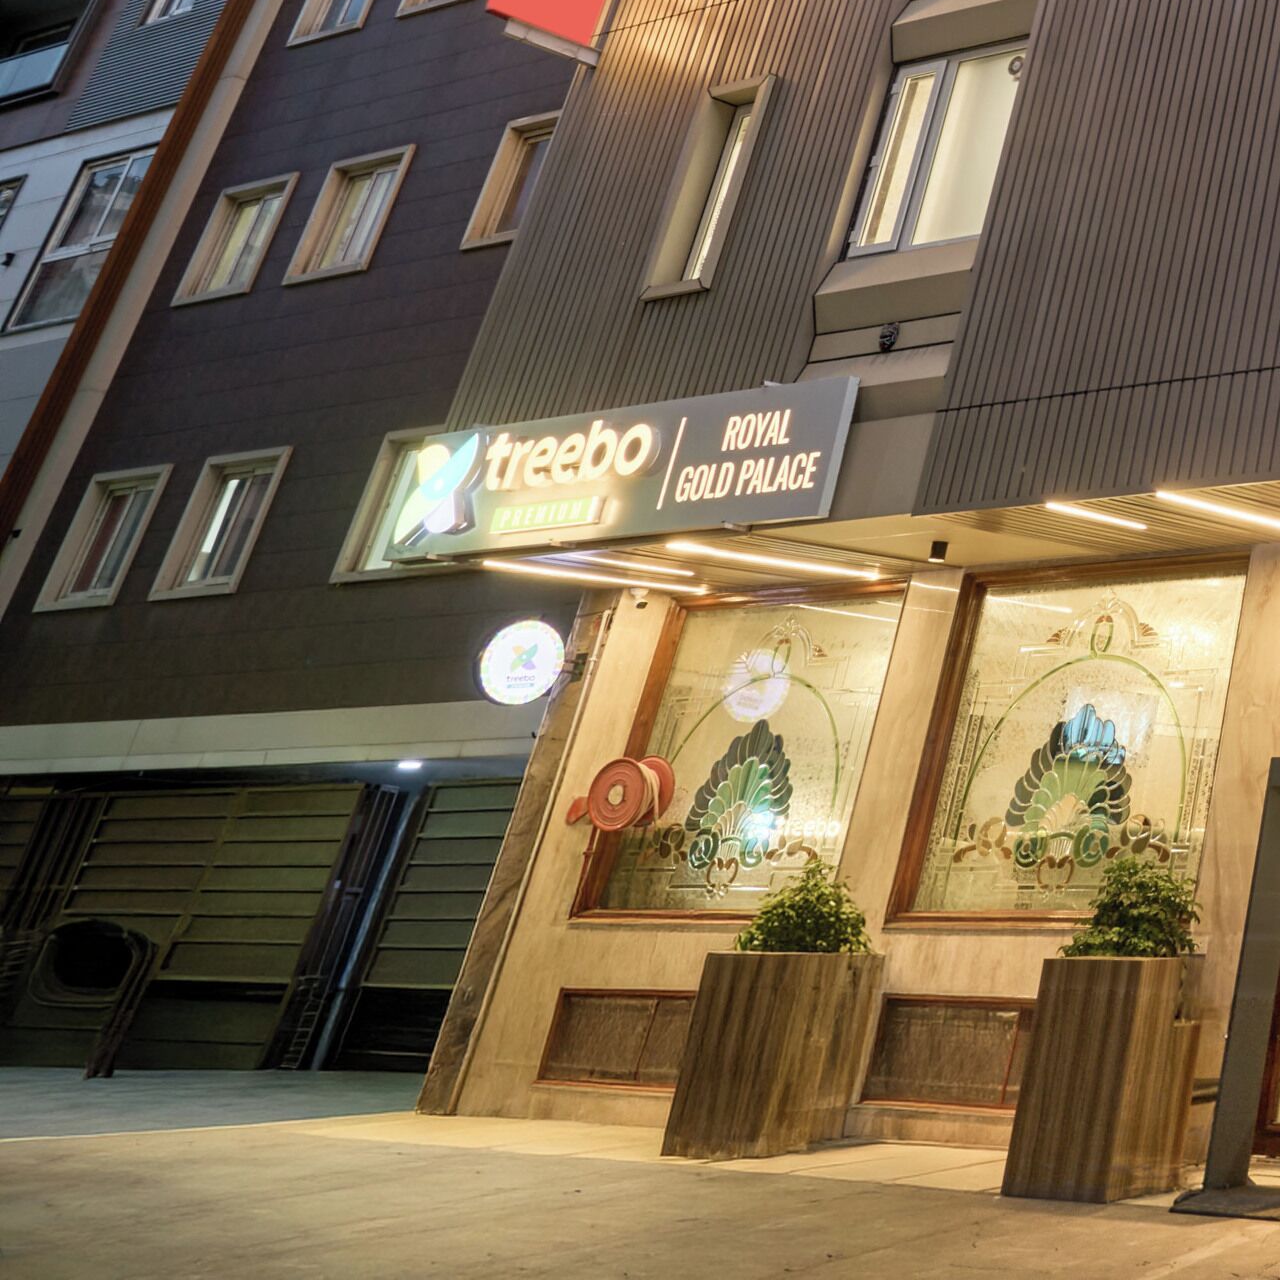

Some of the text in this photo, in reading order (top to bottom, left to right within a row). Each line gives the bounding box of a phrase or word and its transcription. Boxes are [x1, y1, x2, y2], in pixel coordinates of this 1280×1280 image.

[720, 408, 792, 452] ROYAL
[485, 419, 653, 491] treebo
[674, 451, 821, 504] GOLD PALACE
[498, 500, 583, 529] PREMIUM
